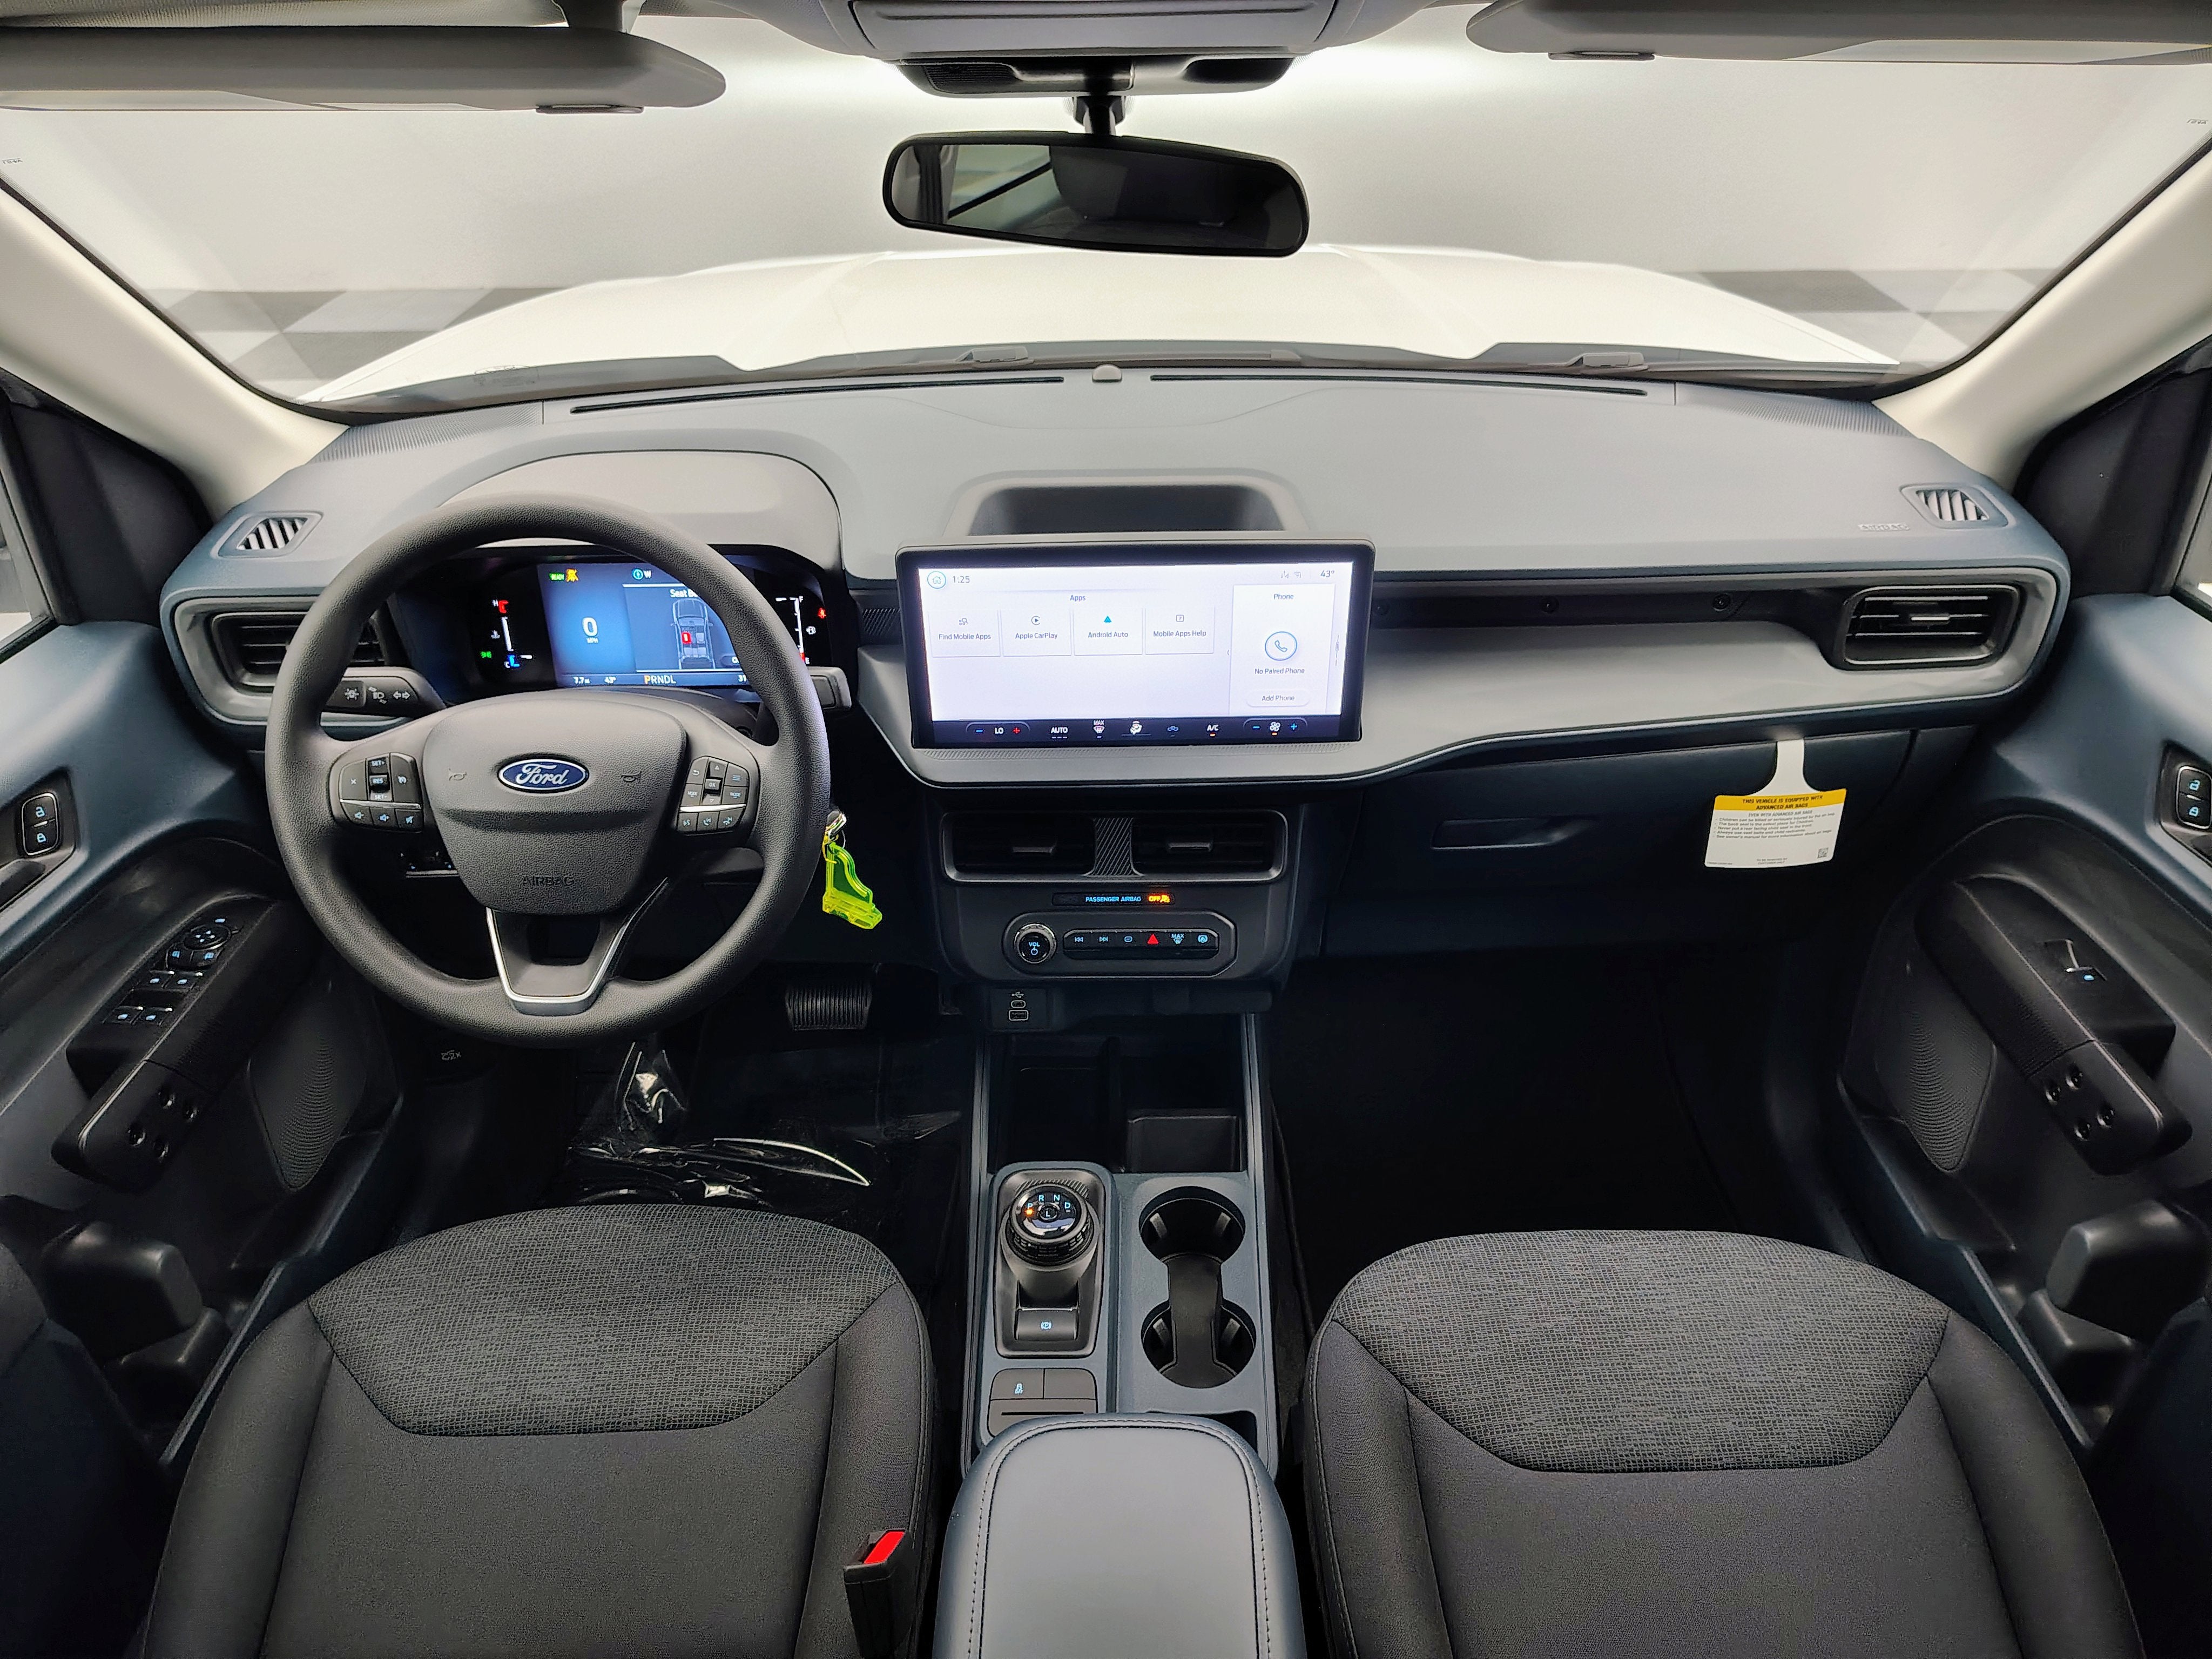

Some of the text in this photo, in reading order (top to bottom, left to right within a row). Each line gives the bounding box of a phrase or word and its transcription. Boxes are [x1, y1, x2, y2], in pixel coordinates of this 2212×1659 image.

[670, 589, 687, 597] Seat
[516, 764, 570, 785] Ford
[522, 875, 574, 886] AIRBAG
